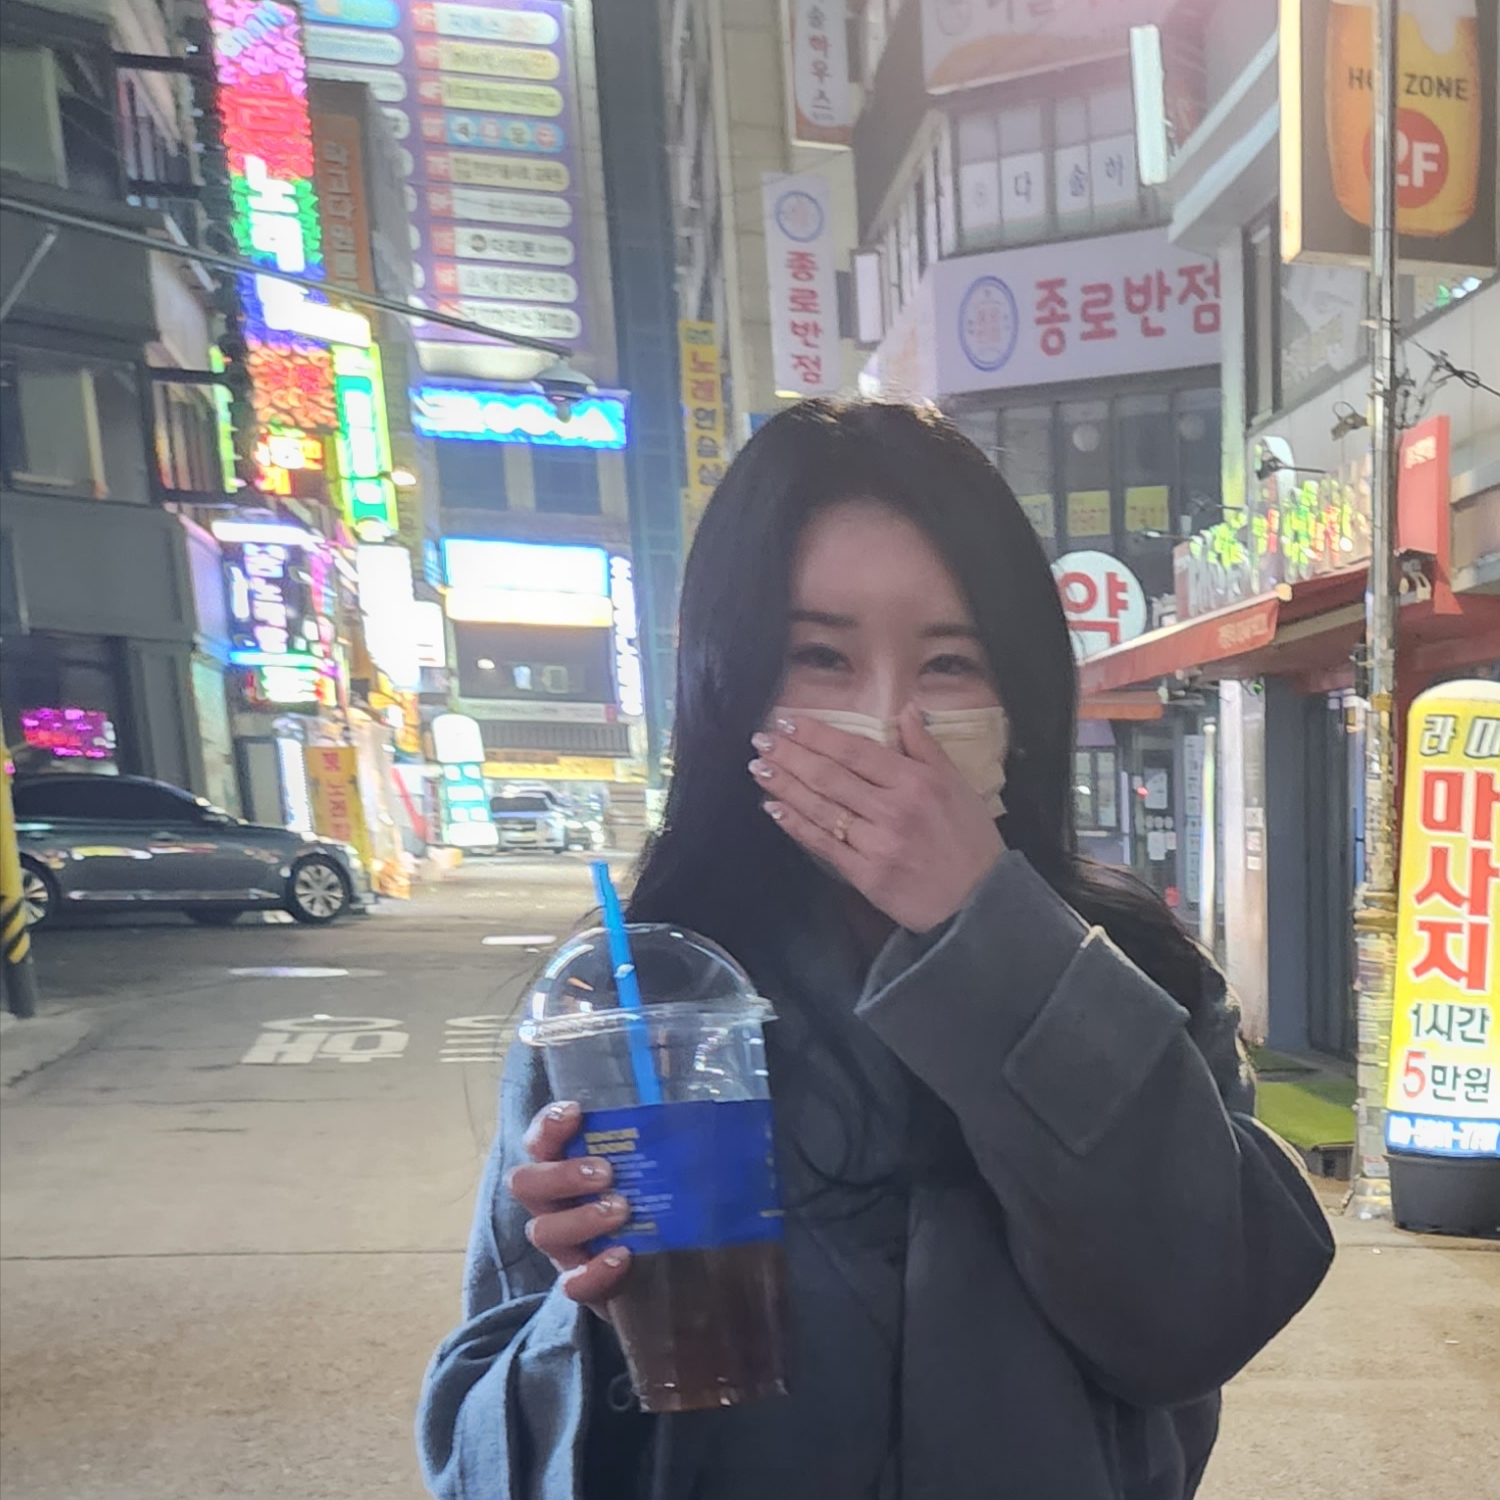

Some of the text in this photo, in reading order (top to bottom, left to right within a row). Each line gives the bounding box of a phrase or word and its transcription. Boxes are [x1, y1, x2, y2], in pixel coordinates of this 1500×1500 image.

[1402, 73, 1468, 102] ZONE
[785, 250, 825, 385] 종로반점
[1034, 259, 1221, 356] 종로반점
[1057, 571, 1129, 646] 약
[1411, 1002, 1490, 1044] 1시간
[1402, 1050, 1491, 1104] 5만원
